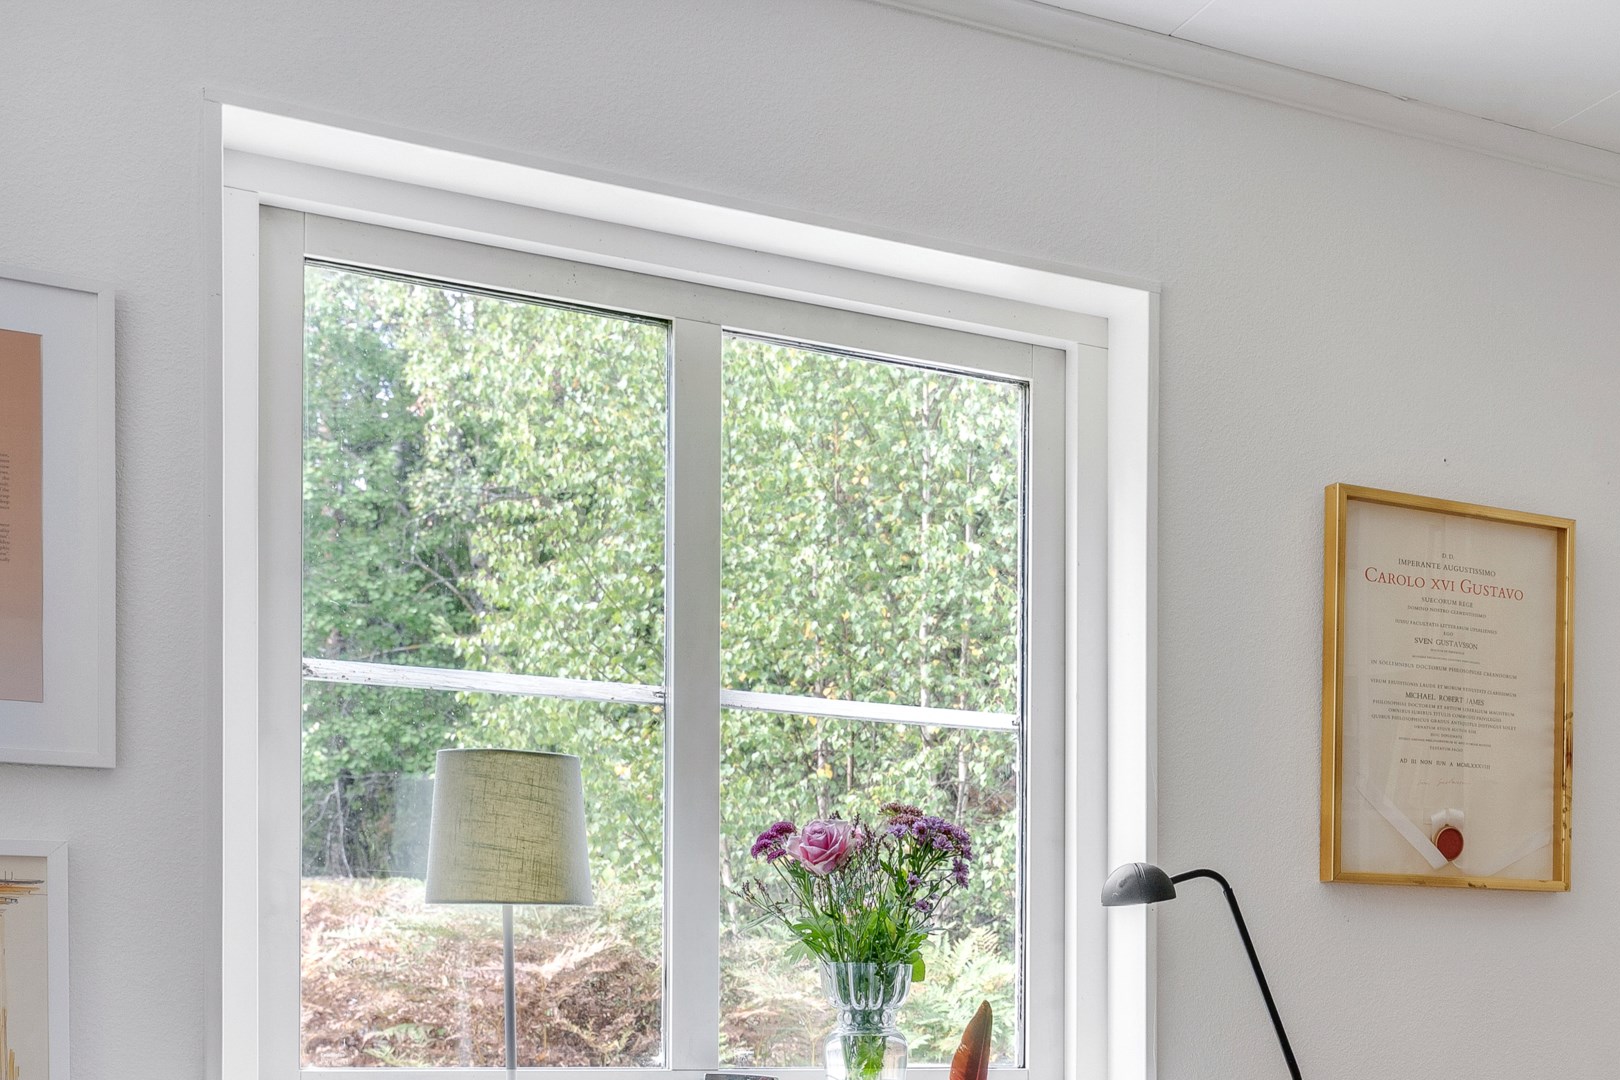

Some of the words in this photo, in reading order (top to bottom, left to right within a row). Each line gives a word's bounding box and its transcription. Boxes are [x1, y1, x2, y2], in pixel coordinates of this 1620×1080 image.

[1398, 559, 1441, 570] IMPERANTE
[1443, 564, 1496, 577] AUGUSTISSIMO
[1365, 567, 1425, 588] CAROLO
[1431, 578, 1455, 592] XVI
[1460, 579, 1524, 601] GUSTAVO
[1414, 637, 1433, 645] SVEN
[1436, 639, 1478, 650] GUSTAVSSON
[1405, 692, 1436, 701] MICHAEL
[1439, 695, 1463, 703] ROBERT
[1467, 698, 1485, 706] JAMES
